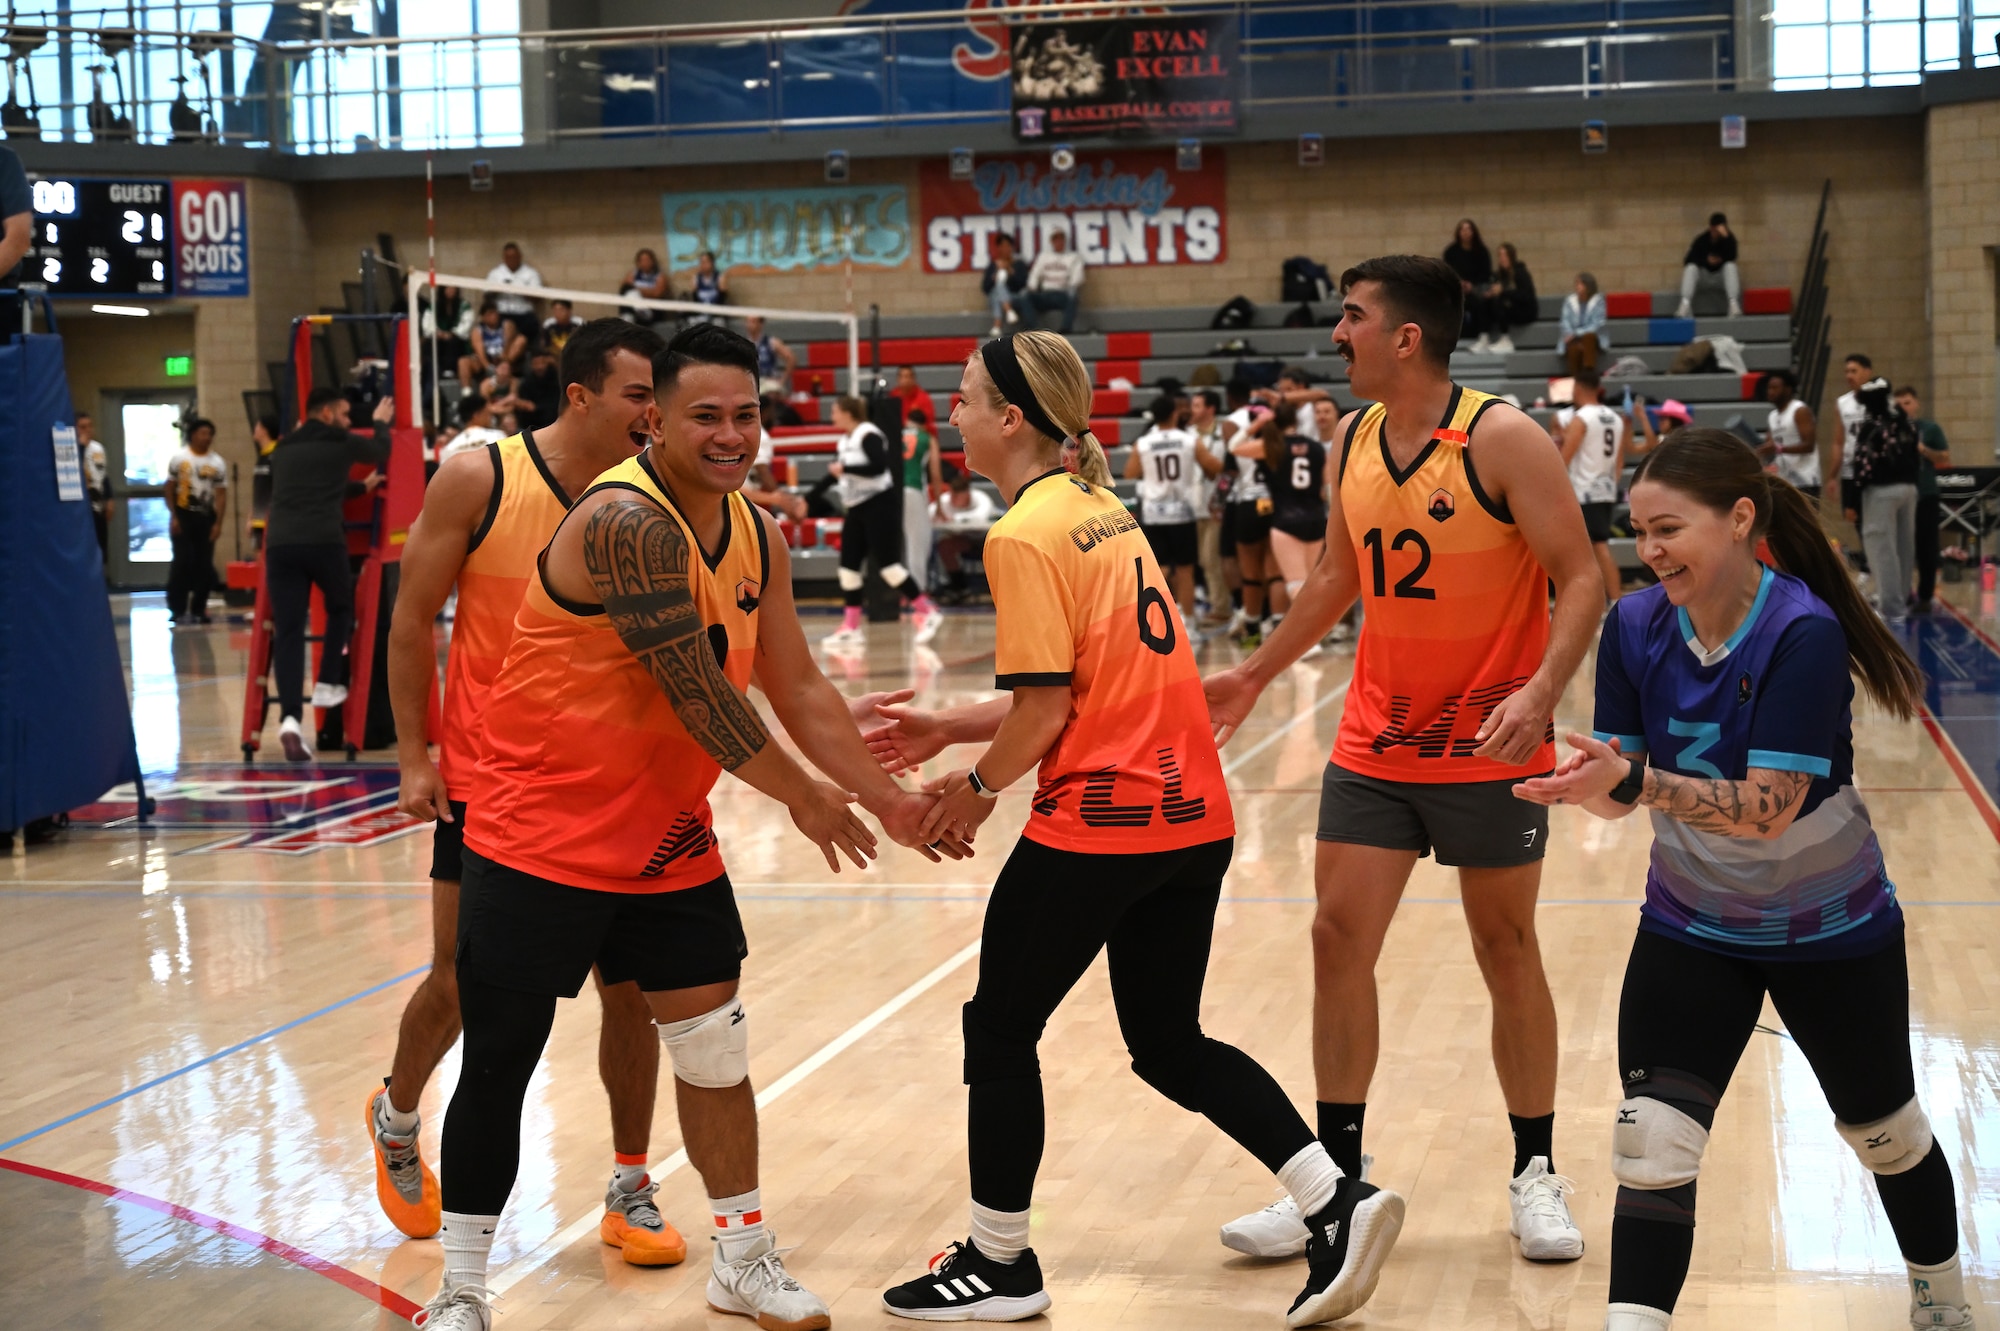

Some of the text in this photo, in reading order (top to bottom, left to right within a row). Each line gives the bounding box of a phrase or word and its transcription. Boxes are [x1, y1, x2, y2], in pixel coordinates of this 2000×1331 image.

[1133, 29, 1208, 53] EVAN
[1116, 55, 1228, 79] EXCELL
[1050, 100, 1232, 122] BASKETBALL COURT
[109, 184, 163, 203] GUEST
[972, 162, 1173, 216] Visiting
[121, 210, 164, 243] 21
[180, 190, 242, 242] GO!
[672, 190, 907, 263] SOPHOMORES
[927, 206, 1221, 272] STUDENTS
[181, 244, 243, 273] SCOTS
[1604, 428, 1615, 458] 9
[1154, 453, 1181, 483] 10
[1291, 456, 1311, 489] 6
[1363, 527, 1436, 600] 12
[1134, 556, 1176, 656] 6
[1667, 716, 1726, 780] 3
